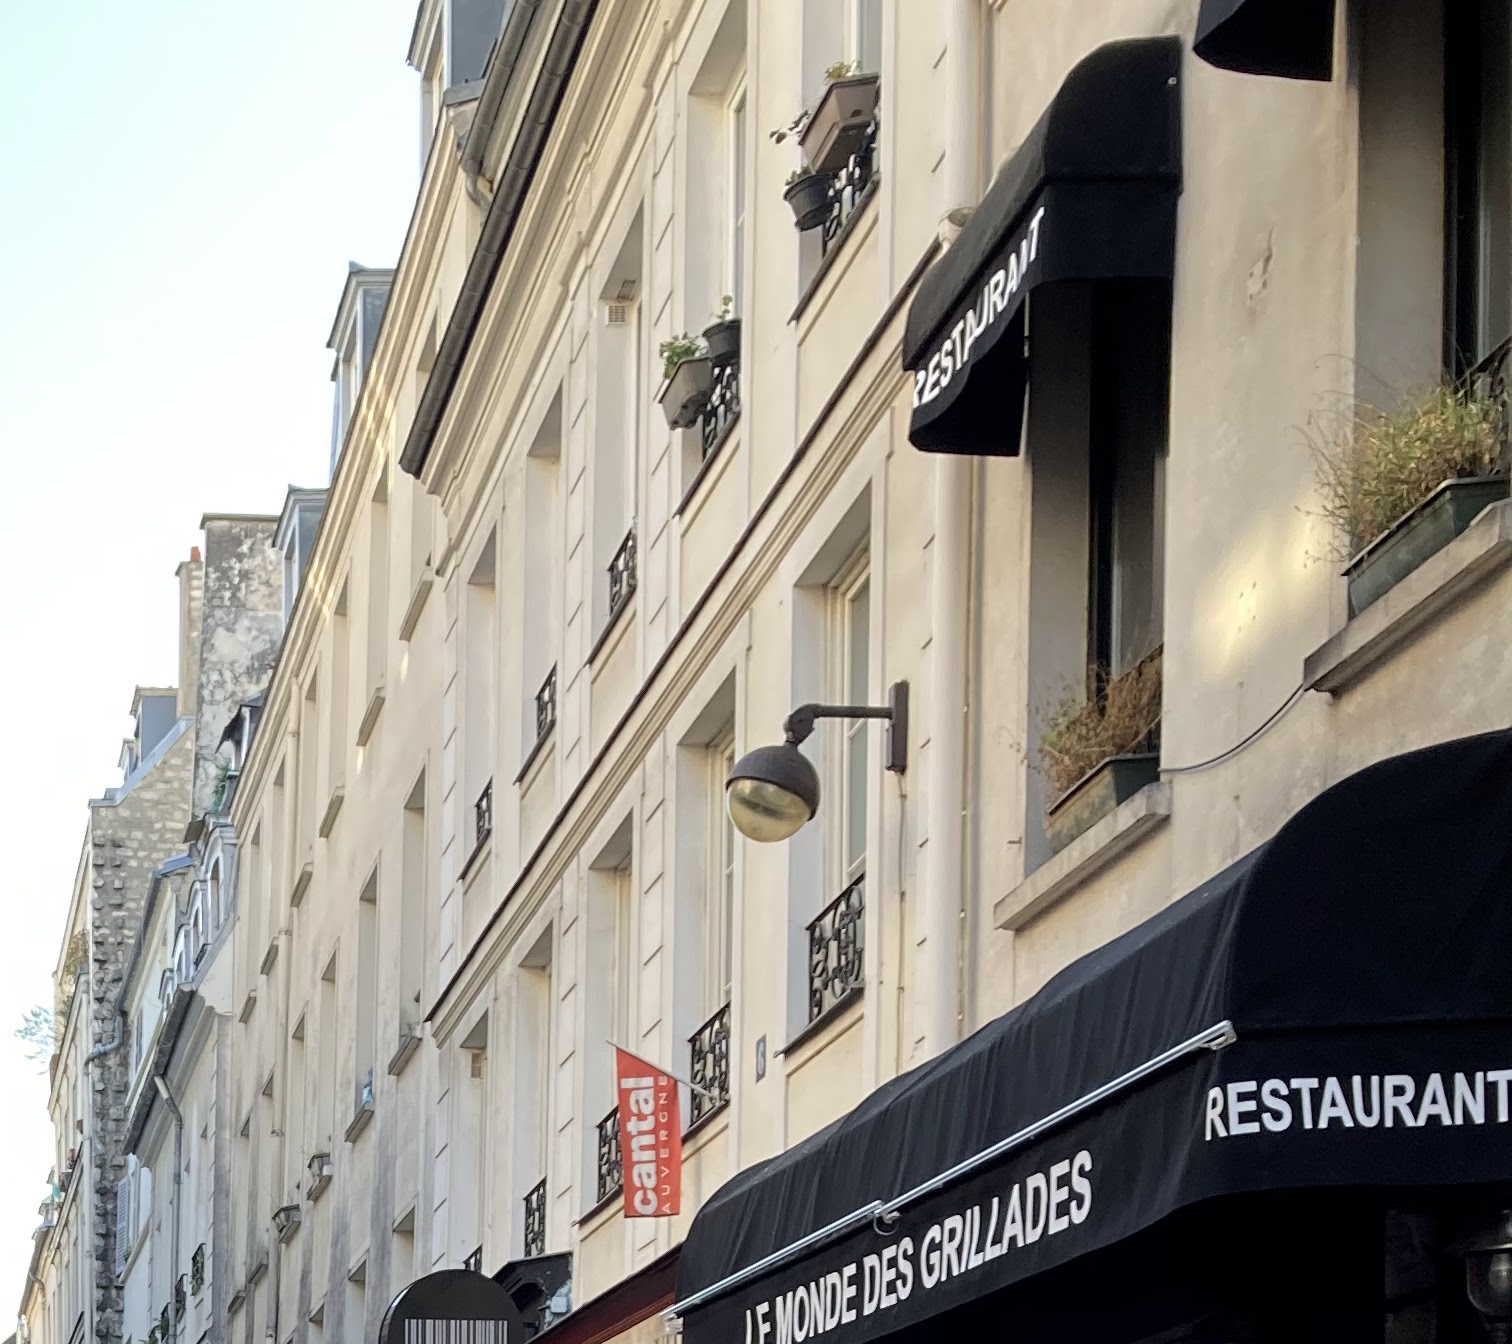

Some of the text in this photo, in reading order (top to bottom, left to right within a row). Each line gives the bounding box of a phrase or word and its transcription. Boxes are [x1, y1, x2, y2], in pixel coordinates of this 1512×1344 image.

[913, 206, 1045, 408] RESTAURANT
[620, 1076, 658, 1215] cantal
[658, 1075, 672, 1214] AUVERGNE
[1205, 1069, 1512, 1141] RESTAURANT
[862, 1237, 914, 1316] DES
[920, 1150, 1093, 1290] GRILLADES
